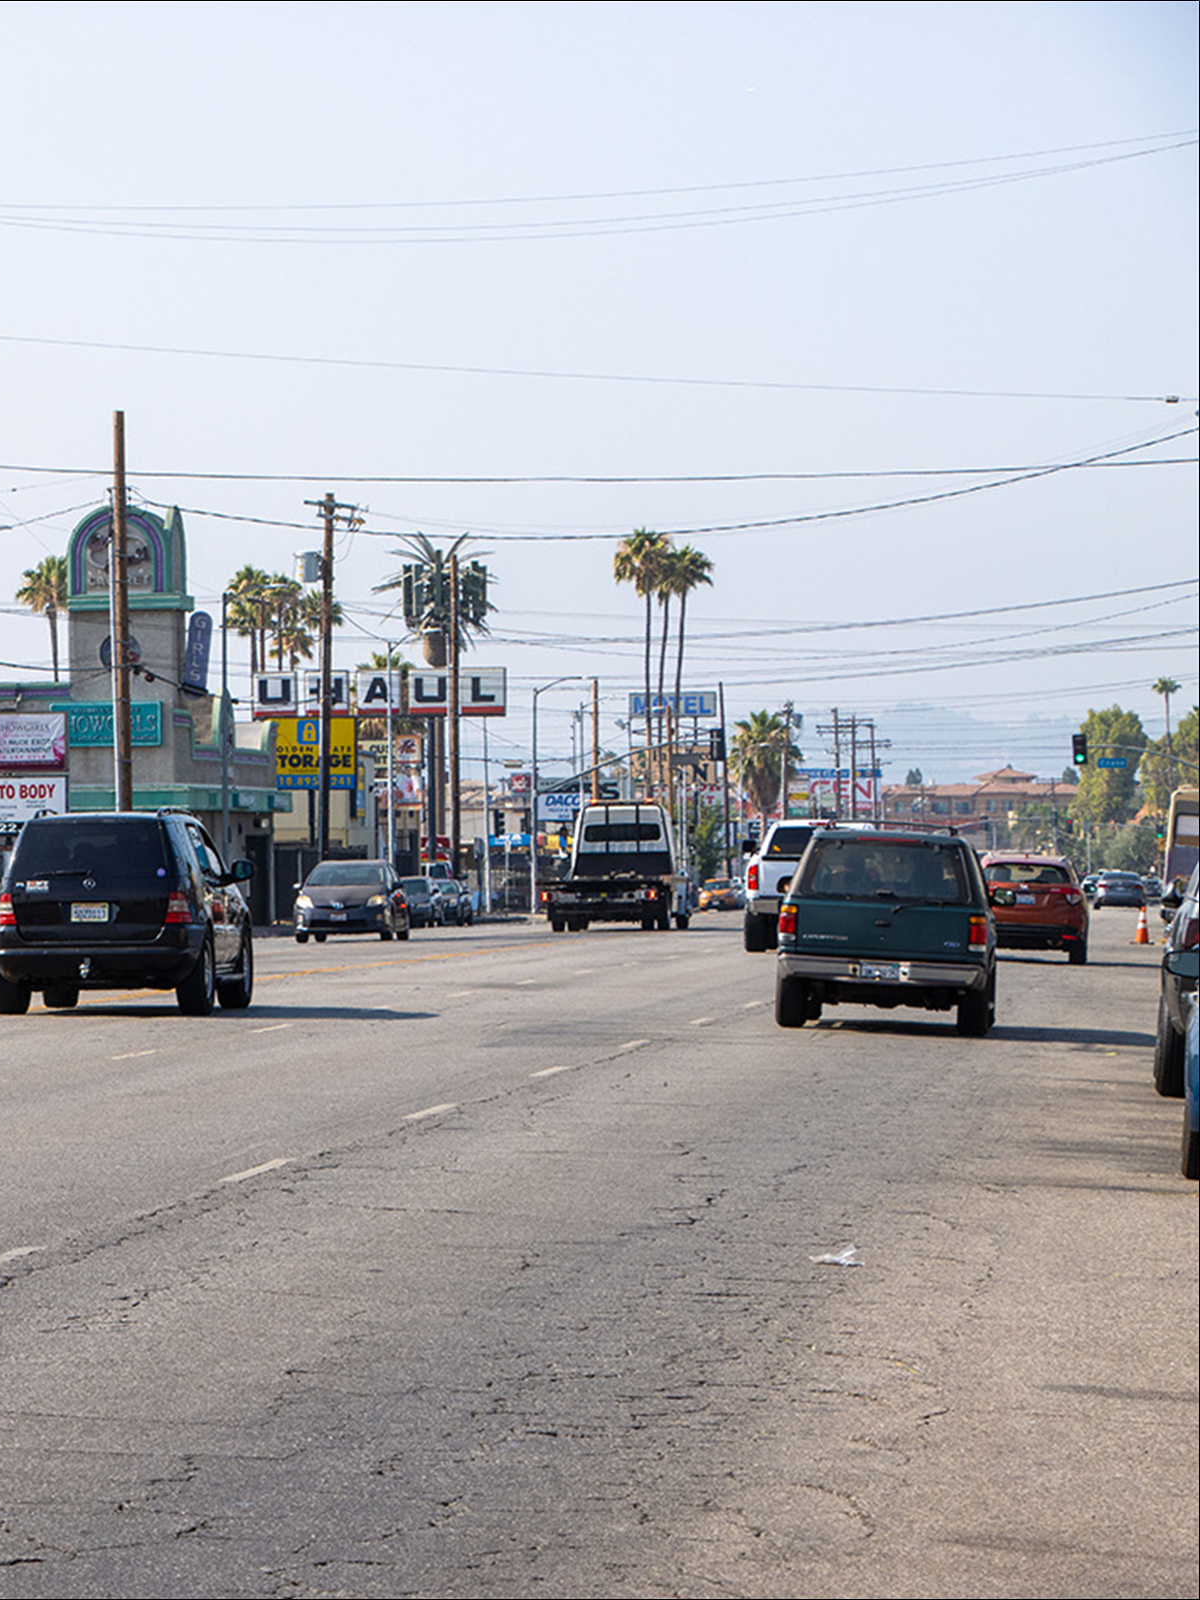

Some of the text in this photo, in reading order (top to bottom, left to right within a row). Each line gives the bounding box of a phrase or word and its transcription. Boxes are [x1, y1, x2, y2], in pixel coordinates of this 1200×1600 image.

[86, 572, 151, 586] CARET
[188, 616, 206, 682] GIRLS
[633, 695, 712, 714] MOTEL
[276, 745, 314, 753] OLDEN
[275, 754, 352, 768] TORGE
[19, 784, 56, 799] BODY
